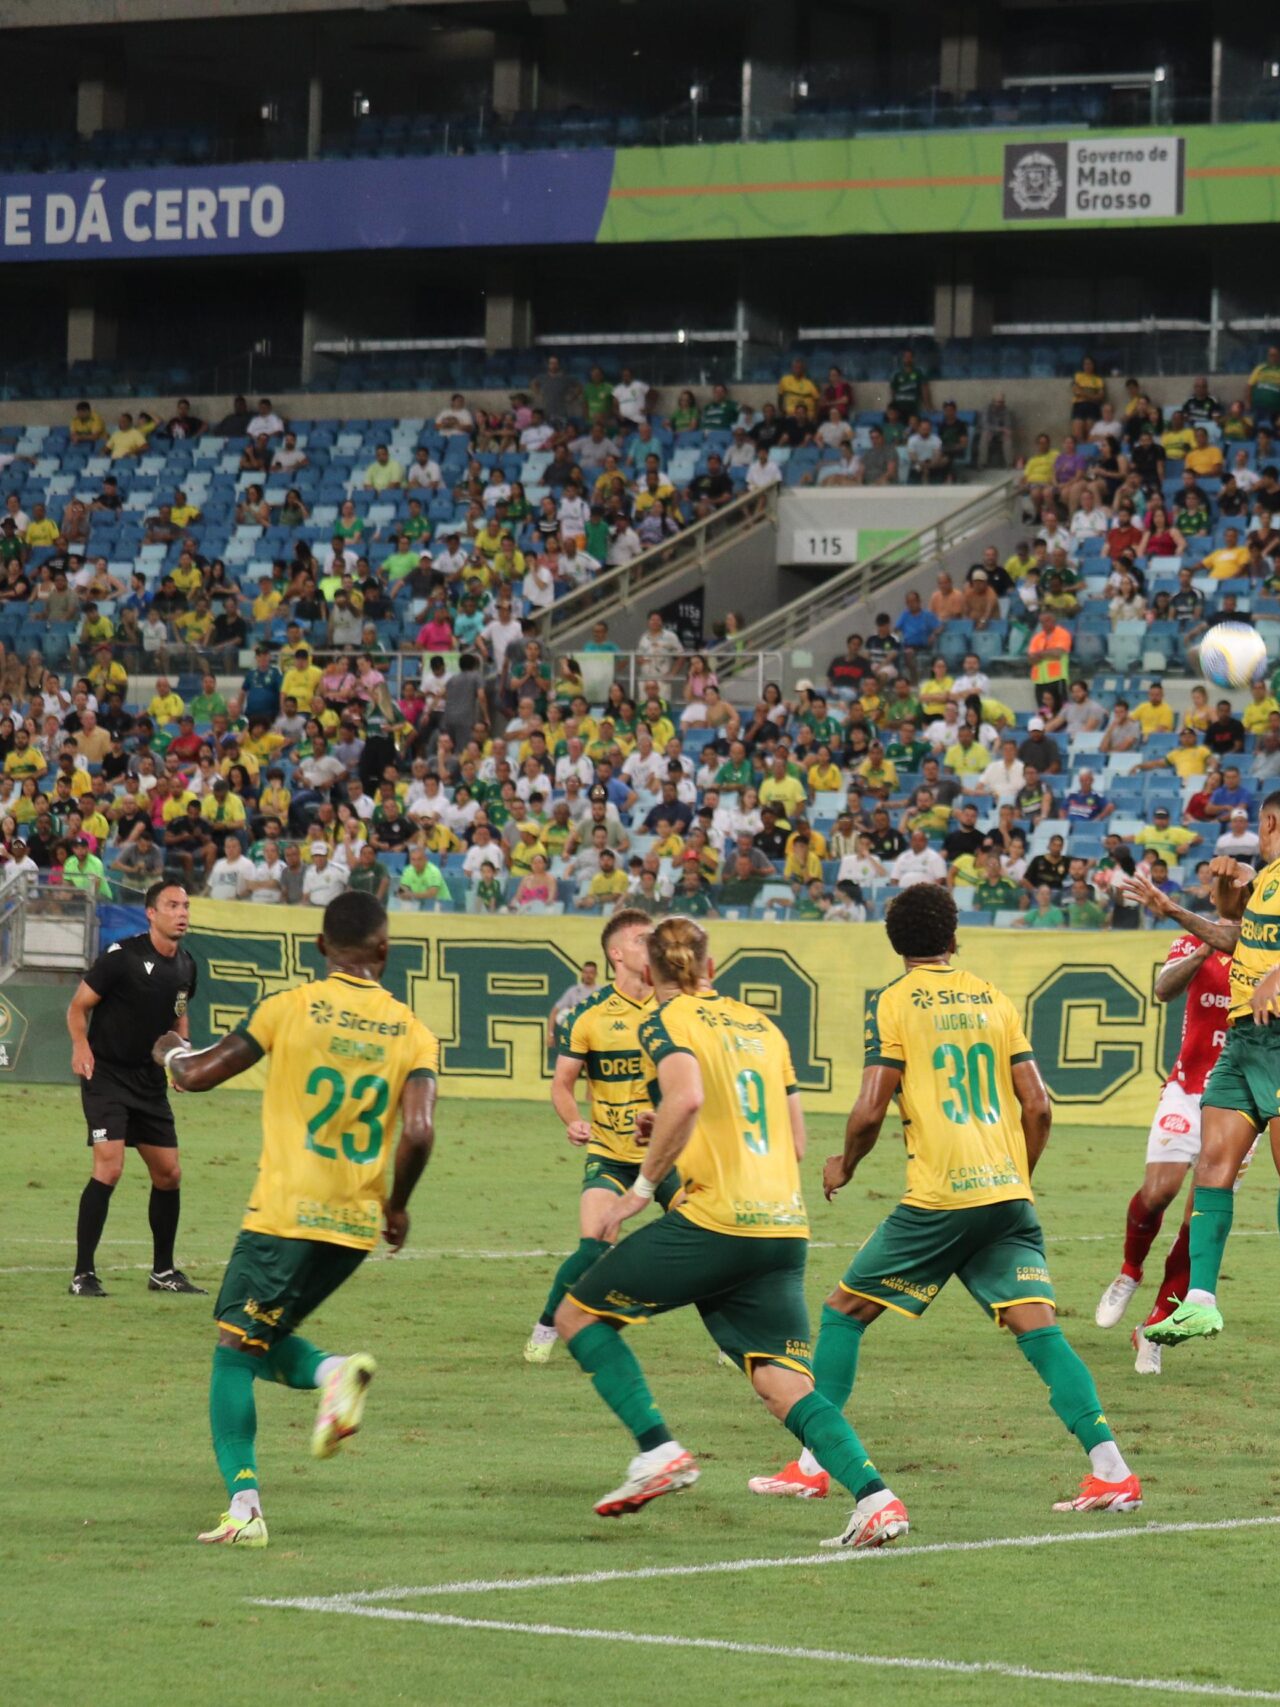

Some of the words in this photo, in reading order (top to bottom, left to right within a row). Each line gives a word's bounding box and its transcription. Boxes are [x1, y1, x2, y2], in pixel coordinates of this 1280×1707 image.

[1077, 148, 1144, 163] Governo
[1149, 146, 1168, 161] de
[1077, 167, 1132, 187] Mato
[0, 195, 32, 245] E
[45, 178, 112, 244] DÁ
[123, 185, 285, 242] CERTO
[1076, 190, 1152, 211] Grosso
[809, 537, 842, 556] 115
[937, 990, 993, 1005] Sicredi
[337, 1009, 407, 1037] Sicredi
[932, 1042, 1000, 1125] 30
[306, 1066, 389, 1165] 23
[736, 1068, 769, 1155] 9
